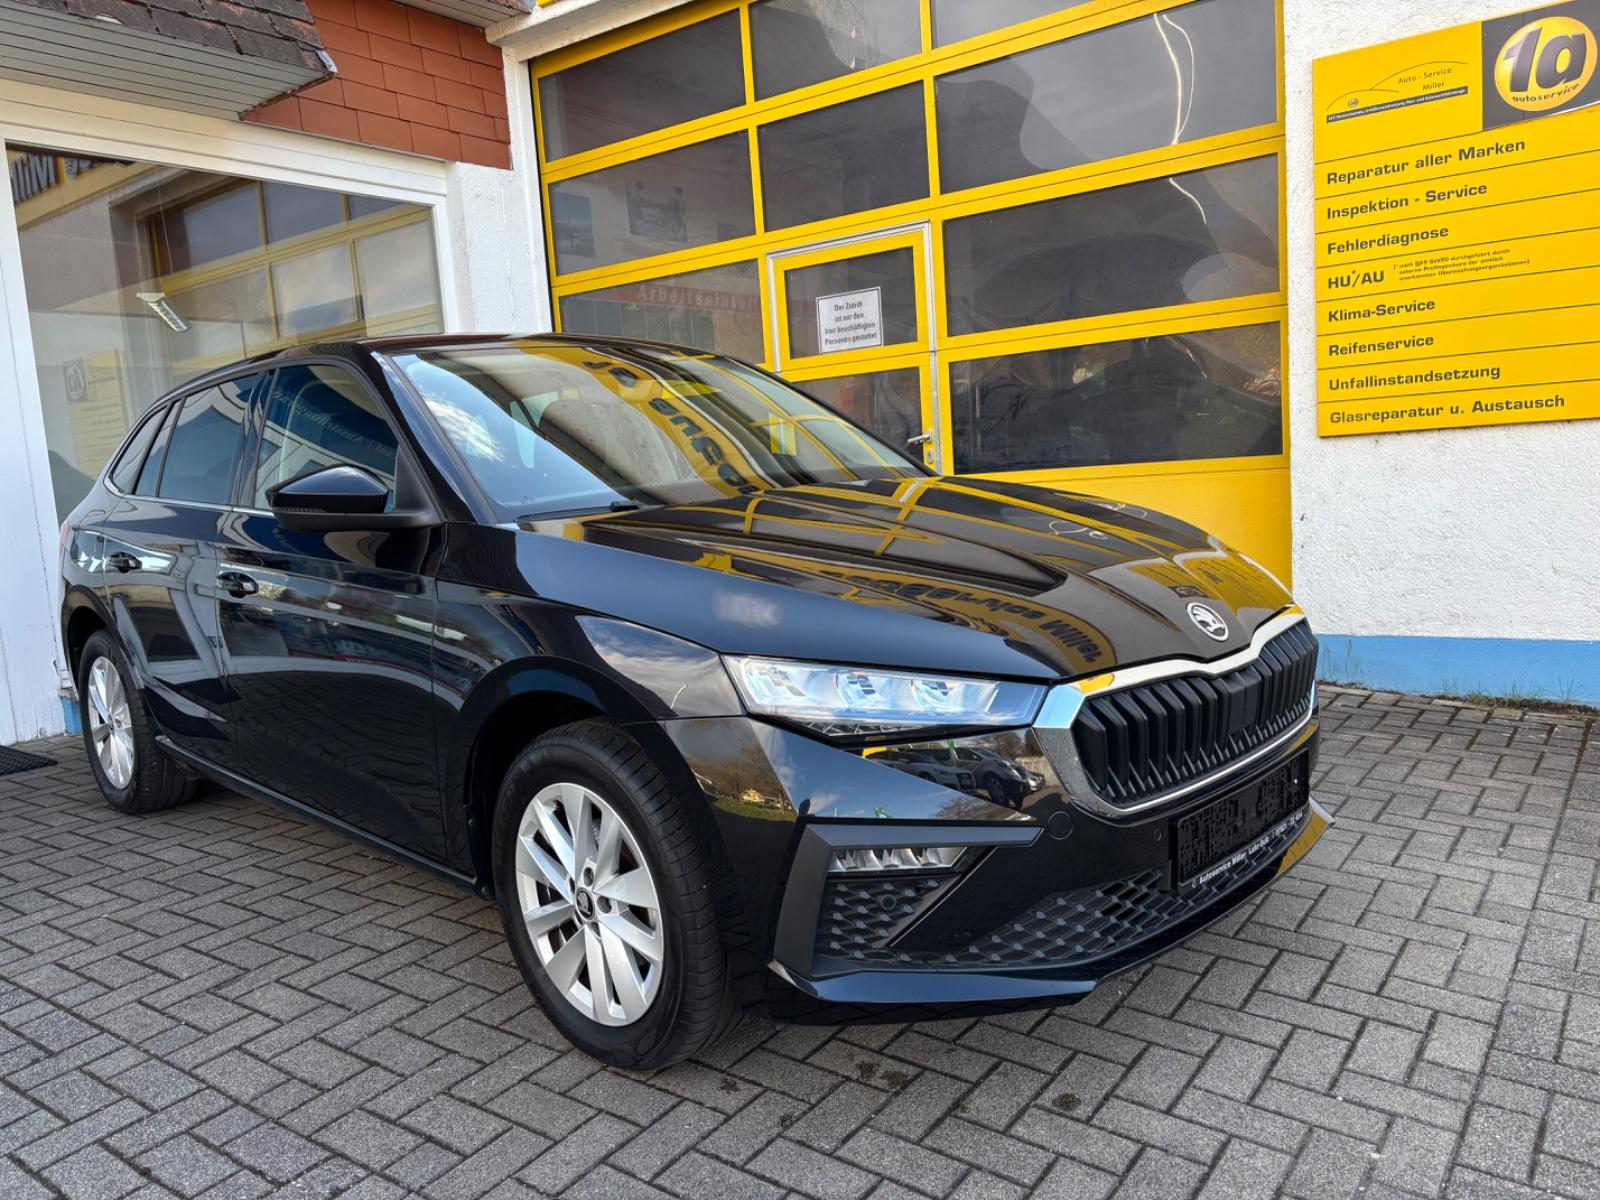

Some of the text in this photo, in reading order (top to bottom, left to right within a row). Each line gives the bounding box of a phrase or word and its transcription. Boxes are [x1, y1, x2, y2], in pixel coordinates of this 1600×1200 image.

[1502, 27, 1588, 93] 1a
[1398, 75, 1417, 85] Auto
[1424, 67, 1453, 79] Service
[1422, 81, 1446, 91] Miller
[1511, 82, 1580, 103] autoservice
[1327, 140, 1526, 185] Reparatur aller Marken
[1326, 196, 1409, 220] Inspektion
[1425, 184, 1488, 203] Service
[1327, 226, 1449, 255] Fehlerdiagnose
[834, 304, 845, 312] Der
[853, 312, 865, 320] den
[1328, 299, 1436, 322] Klima-Service
[1329, 335, 1435, 356] Reifenservice
[1329, 365, 1501, 391] Unfallinstandsetzung
[1330, 395, 1565, 425] Glasreparatur u. Austausch
